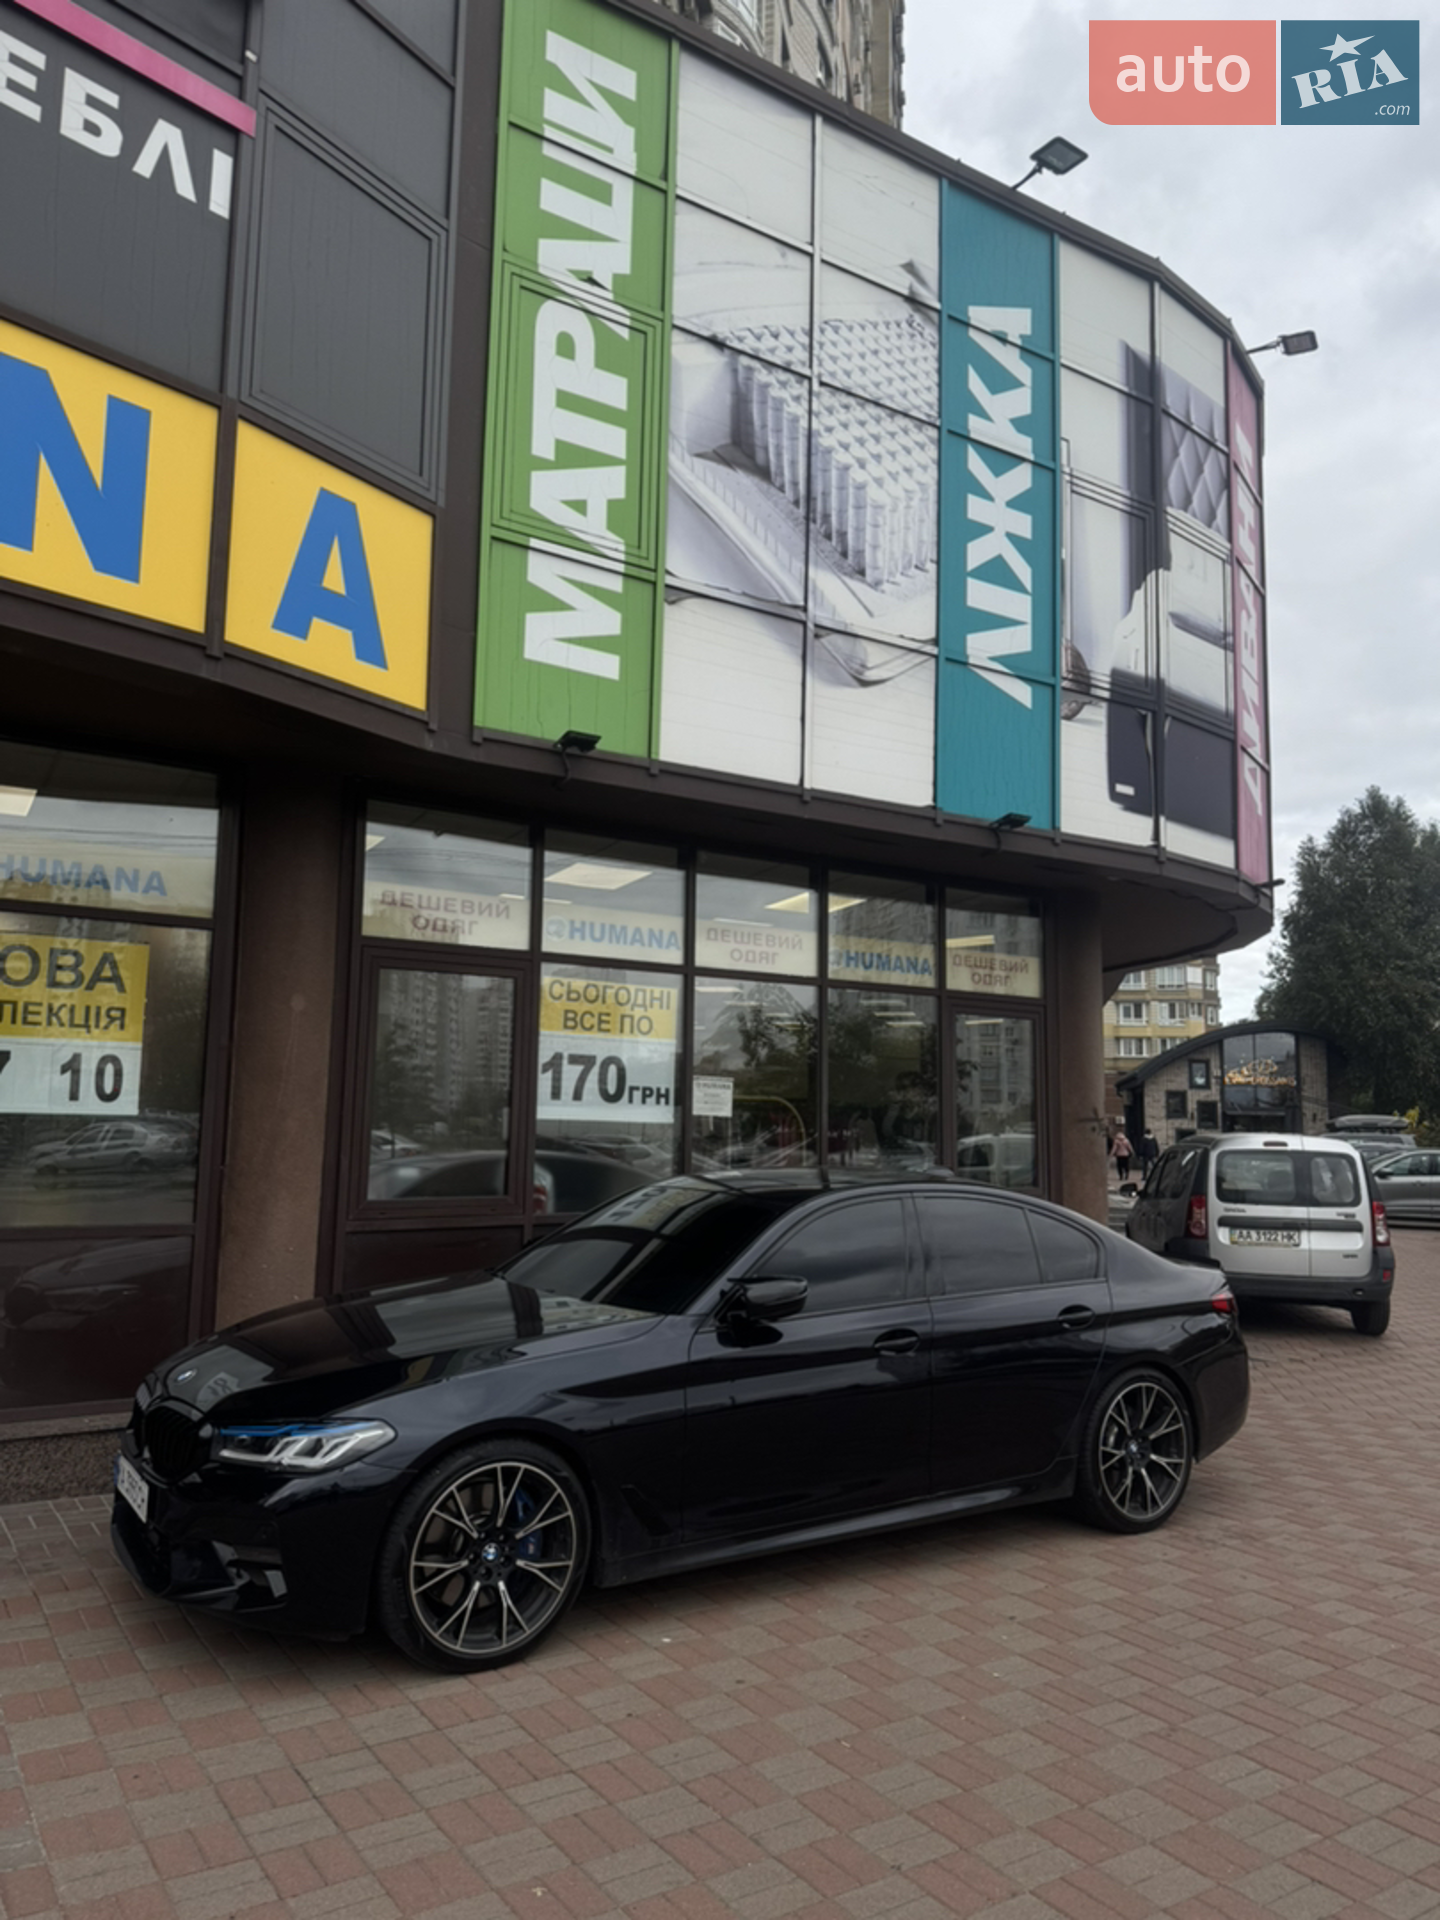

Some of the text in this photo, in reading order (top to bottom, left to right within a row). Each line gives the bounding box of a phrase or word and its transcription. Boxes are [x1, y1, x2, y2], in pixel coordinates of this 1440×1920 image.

[524, 30, 637, 680] МАТРАЦИ
[966, 306, 1032, 709] ЛІЖКА
[1234, 422, 1262, 816] ДИВАНИ
[380, 889, 510, 919] ДЕШЕВИЙ
[411, 913, 478, 936] ОДЯГ
[568, 919, 681, 951] HUMANA
[706, 927, 803, 951] ДЕШЕВИЙ
[730, 948, 779, 966] ОДЯГ
[844, 950, 932, 976] HUMANA
[952, 953, 1029, 974] ДЕШЕВИЙ
[971, 971, 1012, 988] ОДЯГ
[547, 979, 671, 1012] СЬОГОДНІ
[562, 1009, 653, 1036] ВСЕ ПО
[59, 1052, 124, 1103] 10
[1237, 1230, 1253, 1242] AA
[1255, 1230, 1279, 1242] 3122
